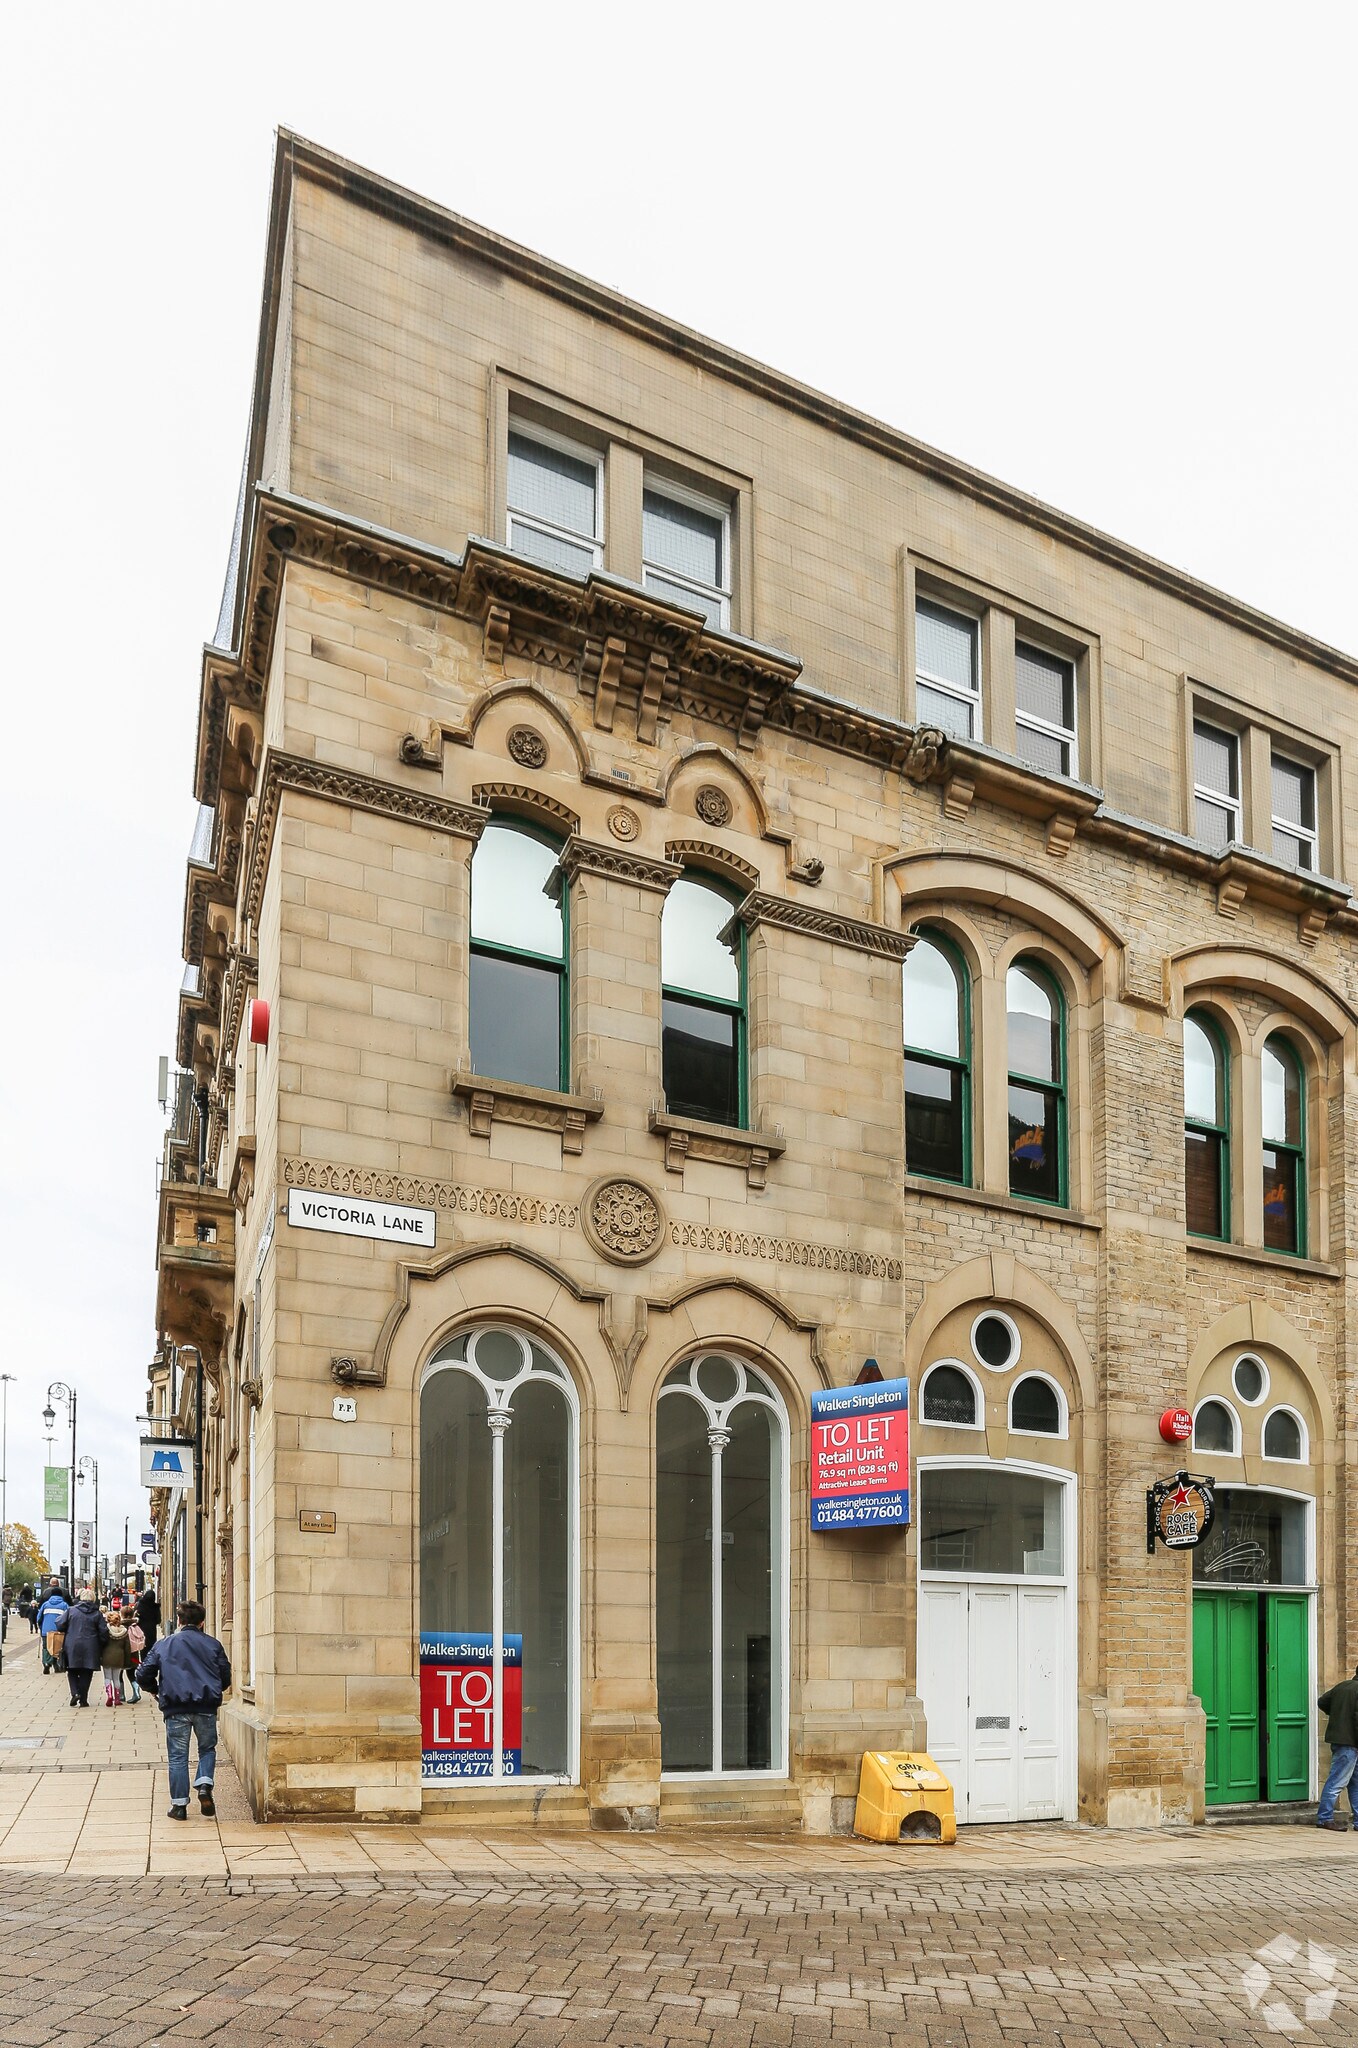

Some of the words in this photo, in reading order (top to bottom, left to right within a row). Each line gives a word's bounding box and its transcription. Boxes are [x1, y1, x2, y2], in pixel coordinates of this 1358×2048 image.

[301, 1202, 376, 1227] VICTORIA
[383, 1214, 424, 1234] LANE
[1175, 1413, 1190, 1422] Hall
[818, 1422, 850, 1448] TO
[856, 1416, 895, 1444] LET
[818, 1448, 853, 1466] Retail
[856, 1445, 884, 1462] Unit
[150, 1471, 185, 1479] SKIPTON
[818, 1469, 836, 1479] 76.9
[836, 1470, 846, 1478] sq
[857, 1464, 876, 1477] (828
[877, 1466, 887, 1475] sq
[888, 1460, 899, 1473] ft)
[818, 1481, 849, 1490] Attractive
[849, 1478, 867, 1487] Lease
[868, 1476, 888, 1485] Terms
[817, 1493, 902, 1510] walkersingleton.co.uk
[1197, 1486, 1211, 1519] BURGERS
[817, 1508, 855, 1523] 01484
[856, 1505, 903, 1520] 477600
[1166, 1510, 1197, 1527] ROCK
[1166, 1523, 1197, 1536] CAFE
[420, 1643, 516, 1659] WalkerSingleon
[436, 1671, 493, 1706] TO
[433, 1708, 493, 1743] LET
[421, 1763, 461, 1776] 01484
[898, 1763, 923, 1771] GRIT
